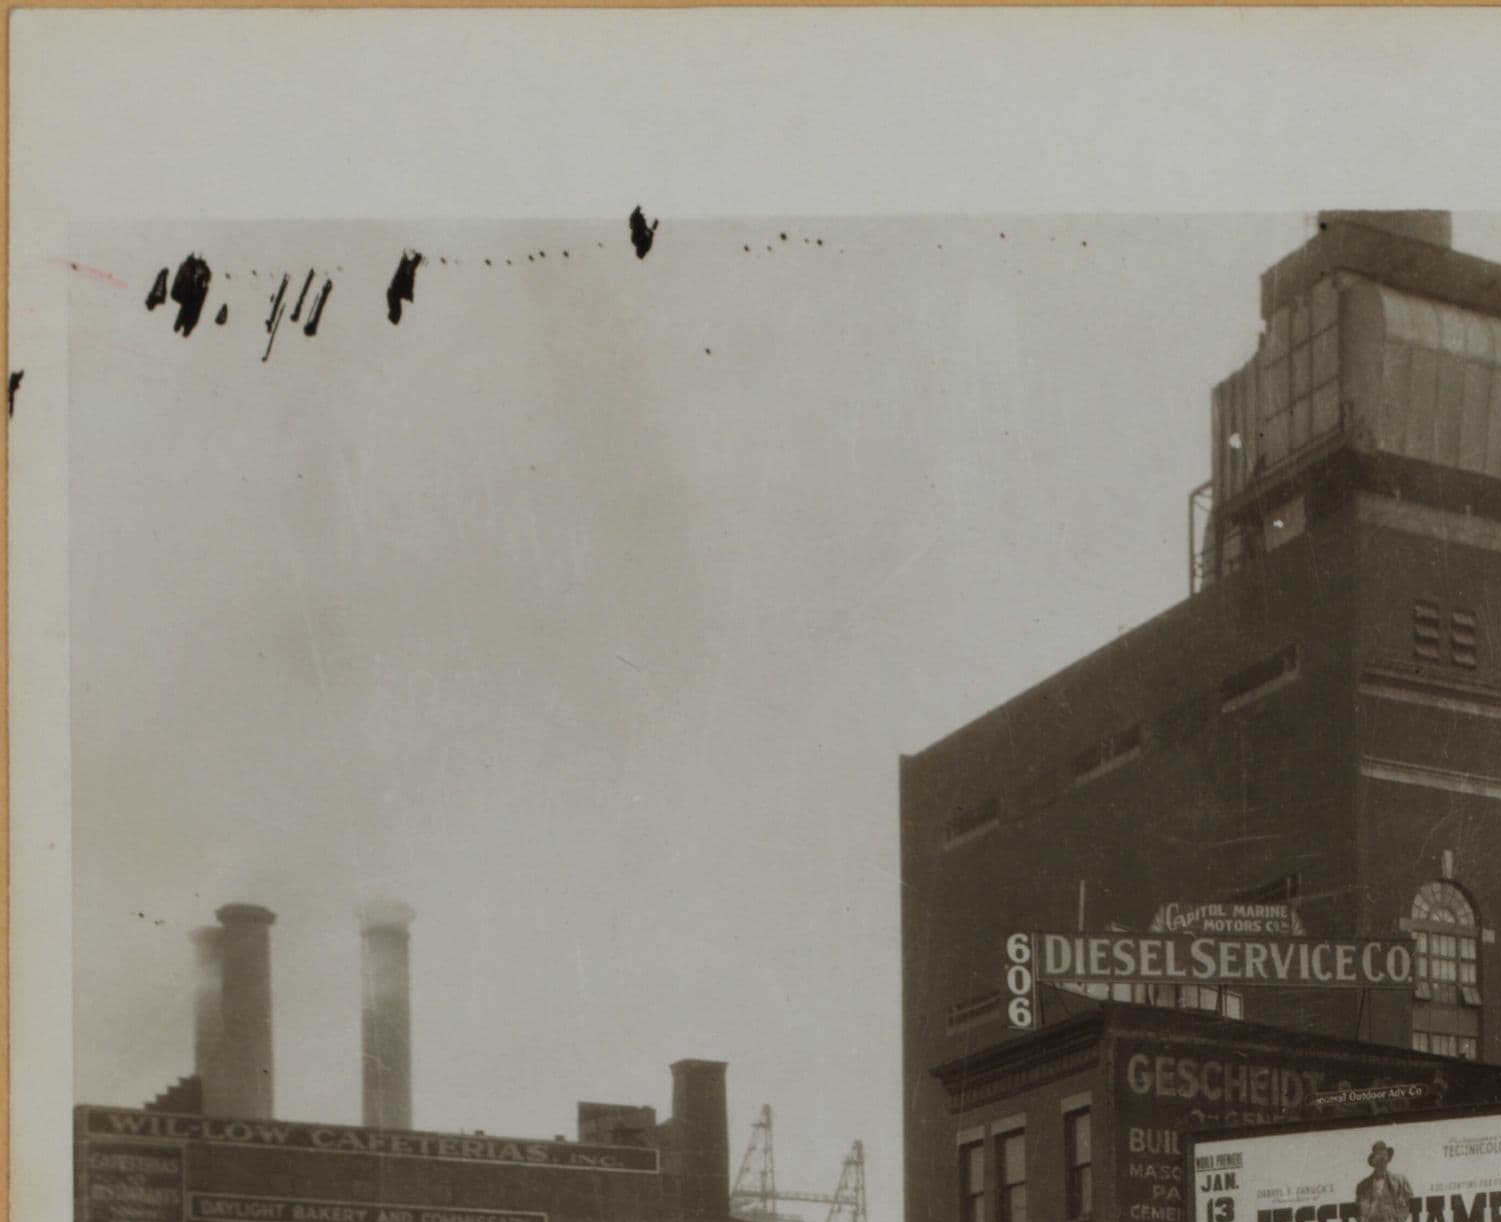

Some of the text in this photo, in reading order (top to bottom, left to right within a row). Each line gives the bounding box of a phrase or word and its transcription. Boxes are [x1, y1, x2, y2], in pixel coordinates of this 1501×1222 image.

[1166, 902, 1288, 931] CAPITOL MARINE
[1203, 919, 1262, 932] MOTORS
[1045, 934, 1187, 977] DIESEL
[1190, 938, 1356, 981] SERVICE
[1006, 933, 1031, 1027] 606
[1127, 1054, 1326, 1107] GESCHEIDT
[1349, 1089, 1387, 1102] Outdoor
[1201, 1172, 1240, 1192] JAN.
[201, 1200, 286, 1218] DAYLIGHT
[292, 1205, 367, 1222] BAKERY
